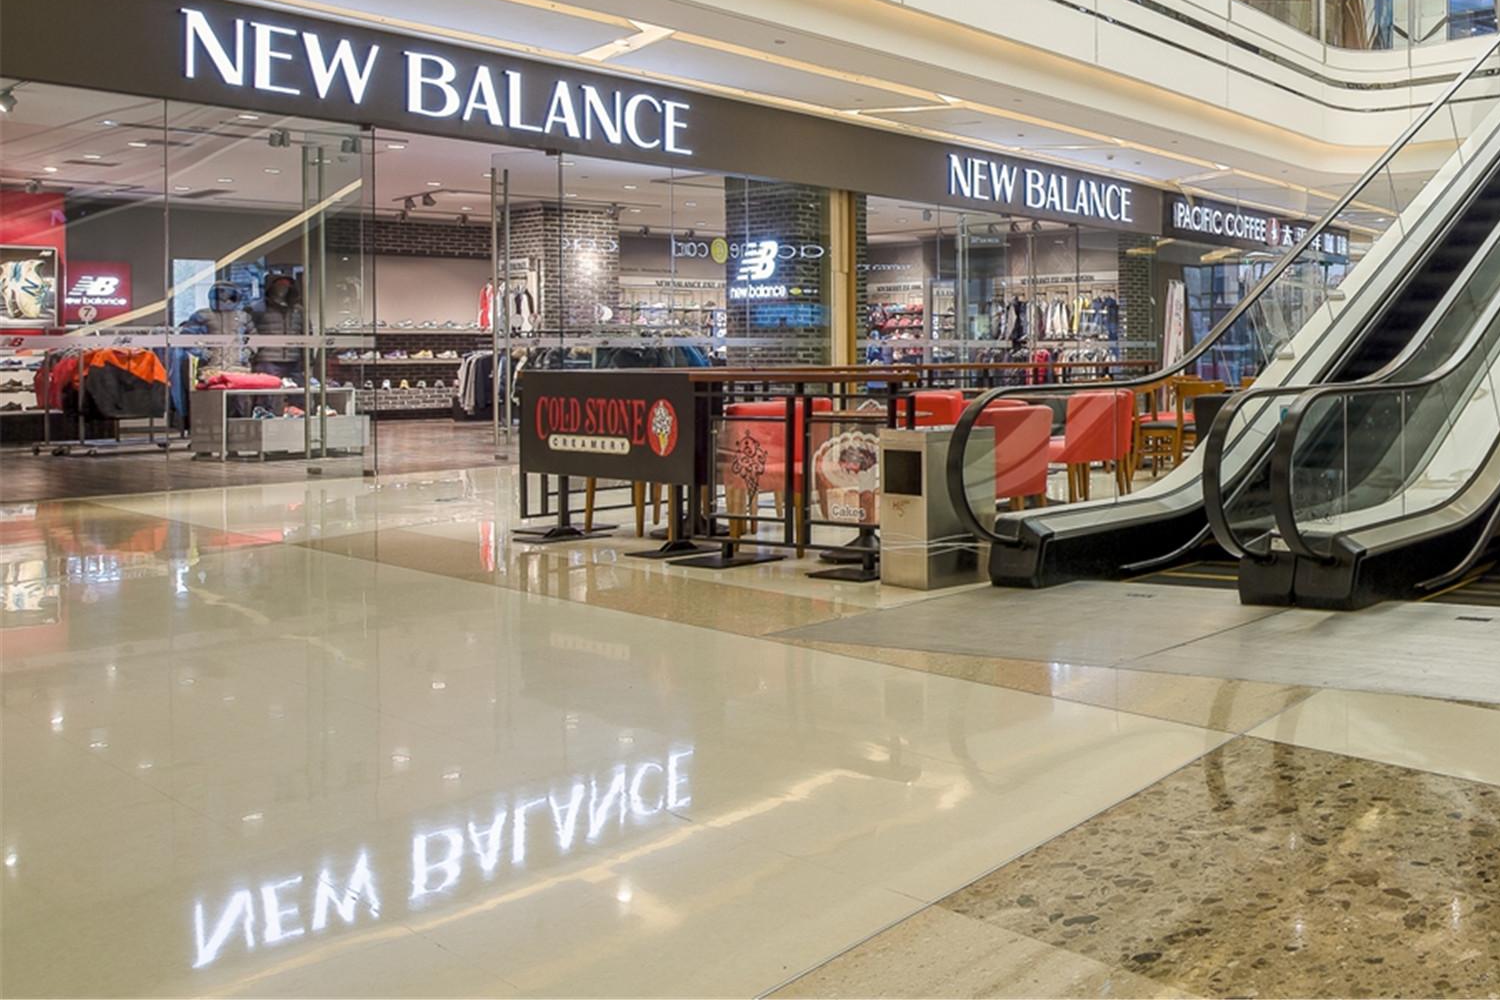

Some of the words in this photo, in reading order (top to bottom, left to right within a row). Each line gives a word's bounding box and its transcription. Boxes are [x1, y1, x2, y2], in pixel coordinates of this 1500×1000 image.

[181, 7, 379, 104] NEW
[404, 50, 693, 155] BALANCE
[949, 154, 1017, 204] NEW
[1025, 168, 1133, 223] BALANCE
[1173, 202, 1223, 235] PACIFIC
[1225, 213, 1267, 242] COFFEE
[82, 297, 127, 306] balance
[730, 287, 748, 299] new
[535, 396, 581, 440] COLD
[585, 397, 647, 445] STONE
[552, 437, 626, 451] CREAMERY
[831, 504, 865, 518] Cakes
